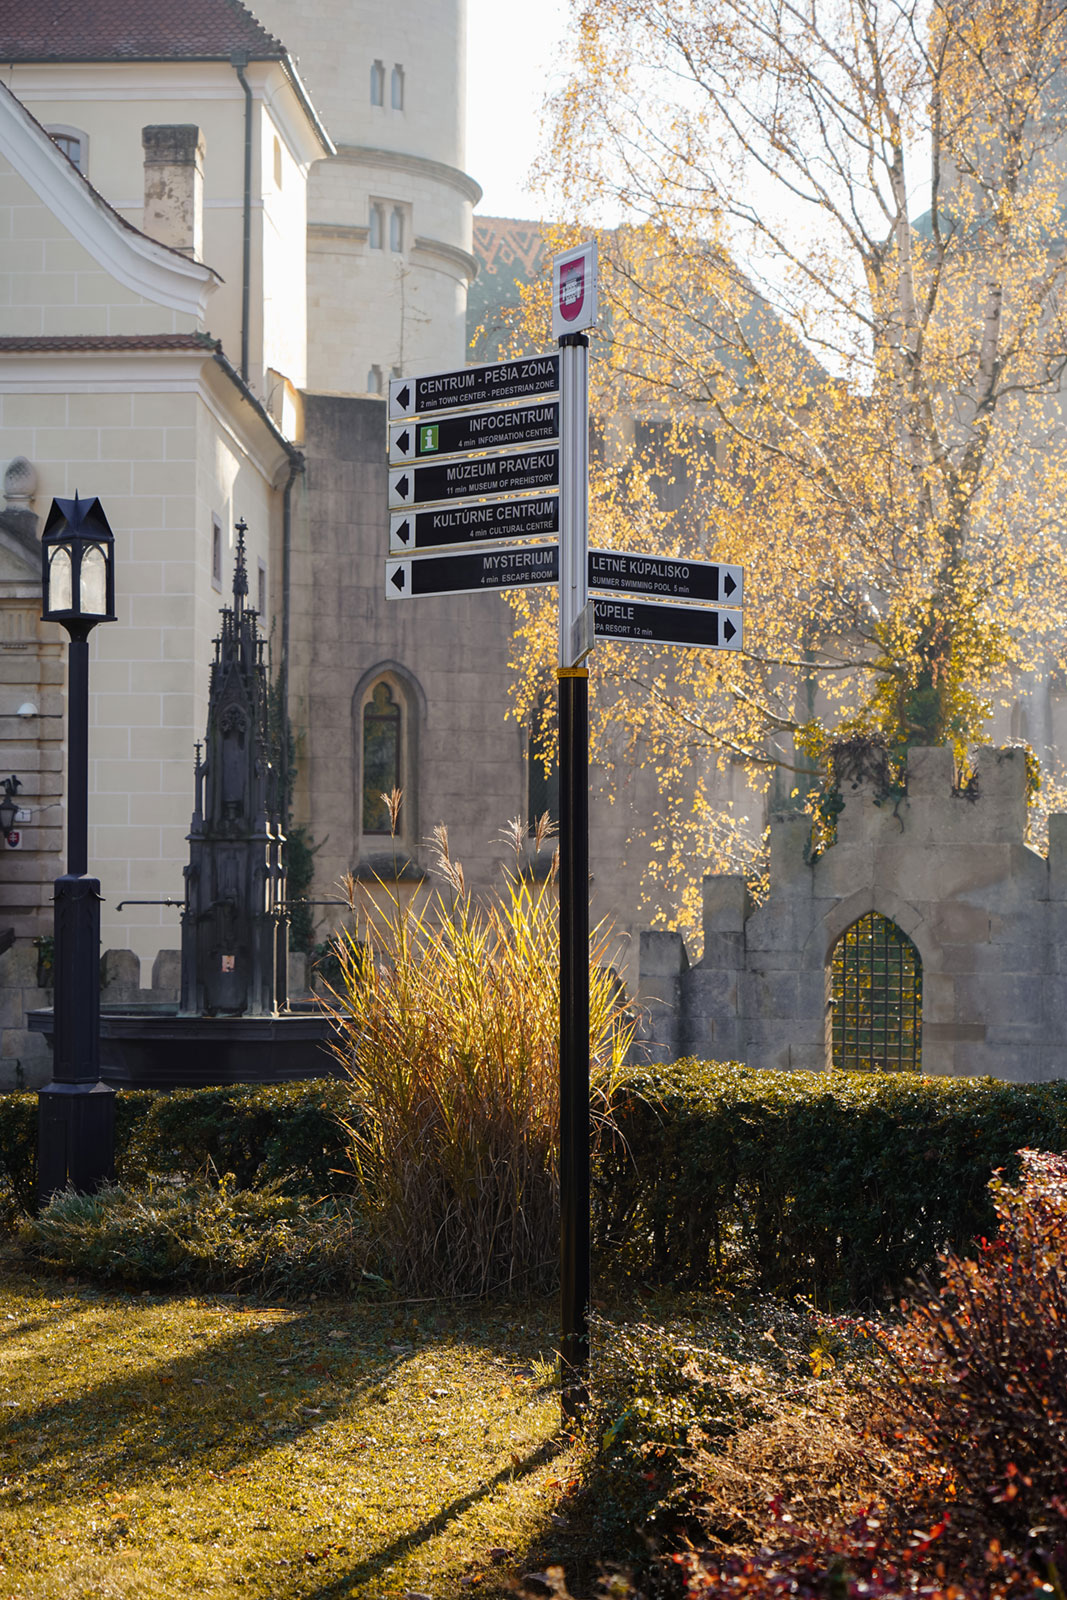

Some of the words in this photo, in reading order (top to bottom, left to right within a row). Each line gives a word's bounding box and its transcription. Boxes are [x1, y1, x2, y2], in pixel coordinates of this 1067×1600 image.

[420, 374, 474, 394] CENTRUM
[485, 366, 518, 384] PEŠIA
[522, 360, 554, 380] ZÓNA
[439, 395, 458, 405] TOWN
[460, 391, 486, 402] CENTER
[492, 384, 533, 397] PEDESTRIAN
[536, 380, 554, 389] ZONE
[470, 408, 553, 432] INFOCENTRUM
[478, 431, 524, 444] INFORMATION
[526, 427, 552, 437] CENTRE
[447, 462, 495, 480] MÚZEUM
[500, 455, 554, 473] PRAVEKU
[469, 481, 498, 492] MUSEUM
[510, 474, 553, 486] PREHISTORY
[434, 509, 493, 528] KULTÚRNE
[497, 501, 553, 520] CENTRUM
[489, 524, 524, 535] CULTURAL
[526, 520, 553, 530] CENTRE
[484, 551, 553, 569] MYSTERIUM
[593, 557, 626, 572] LETNÉ
[630, 560, 689, 579] KÚPALISKO
[502, 573, 529, 582] ESCAPE
[531, 570, 552, 579] ROOM
[592, 576, 619, 586] SUMMER
[621, 579, 652, 589] SWIMMING
[654, 583, 671, 591] POOL
[594, 602, 634, 620] KÚPELE
[606, 625, 630, 634] RESORT
